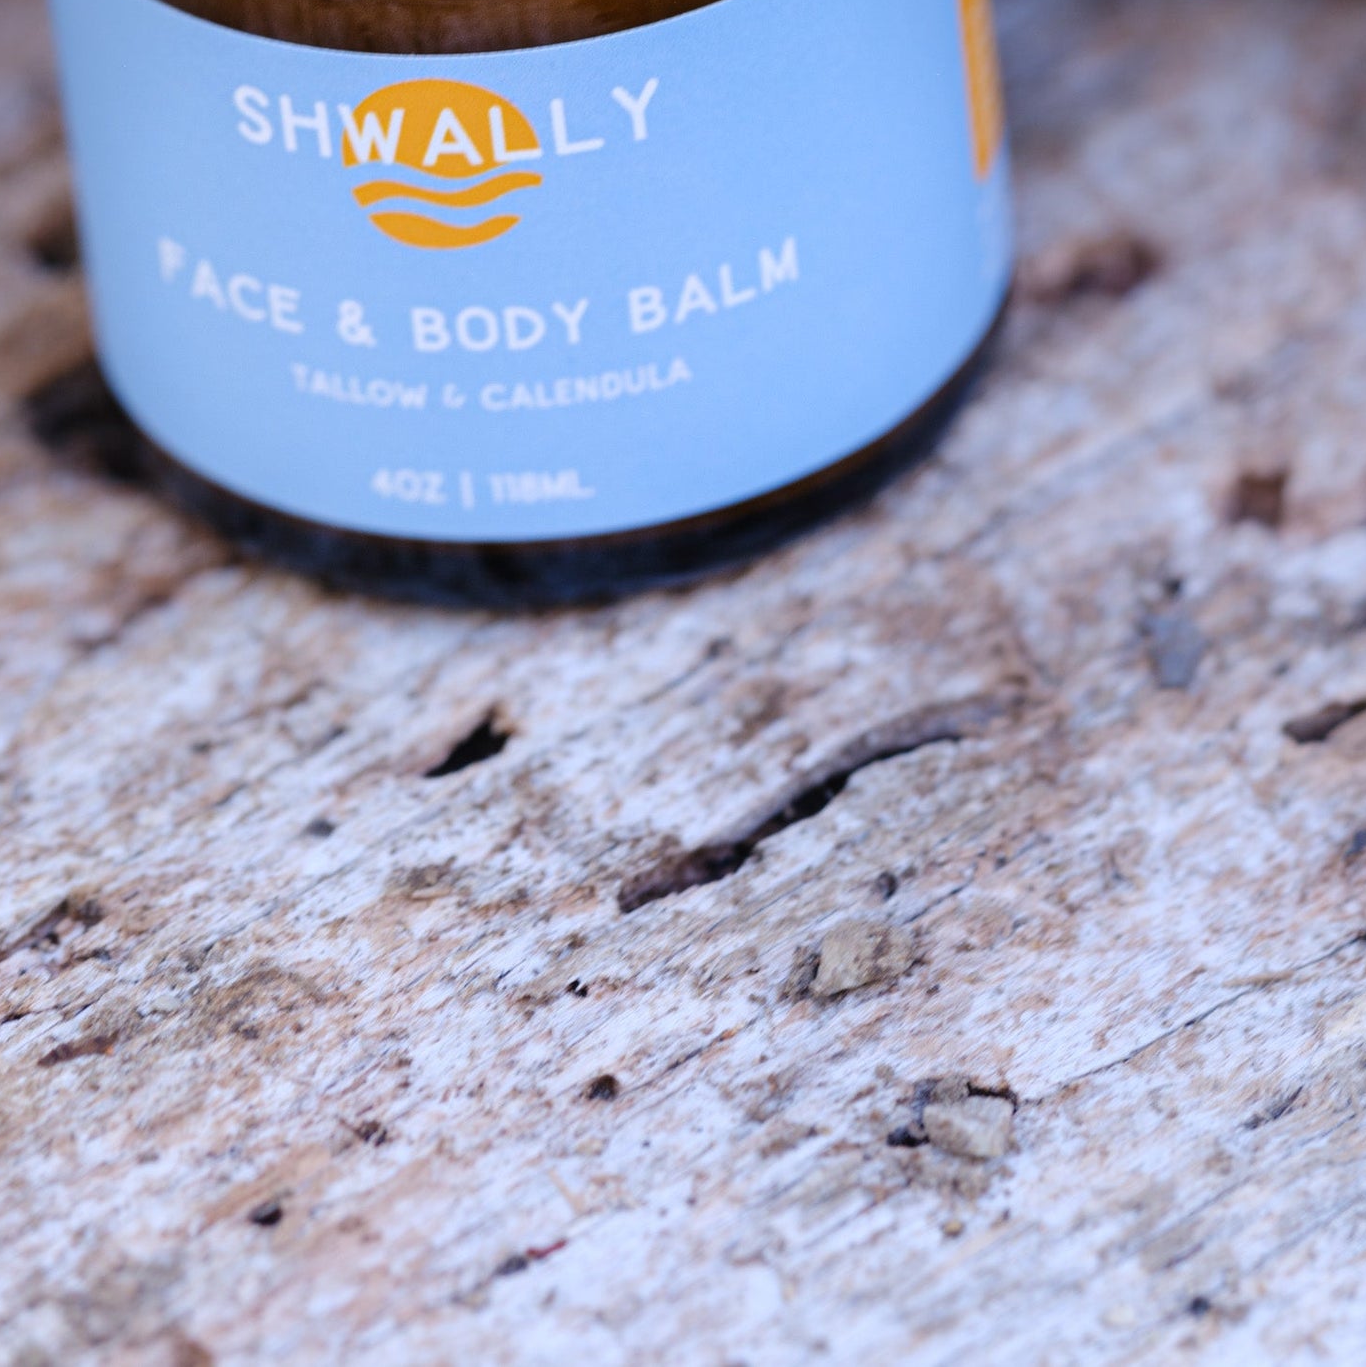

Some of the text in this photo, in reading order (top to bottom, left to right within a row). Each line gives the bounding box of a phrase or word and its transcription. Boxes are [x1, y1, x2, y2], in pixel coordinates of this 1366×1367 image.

[233, 76, 659, 166] SHWALLY
[156, 235, 800, 352] FACE & BODY BALM
[290, 357, 693, 413] TALLOW & CALENDULA
